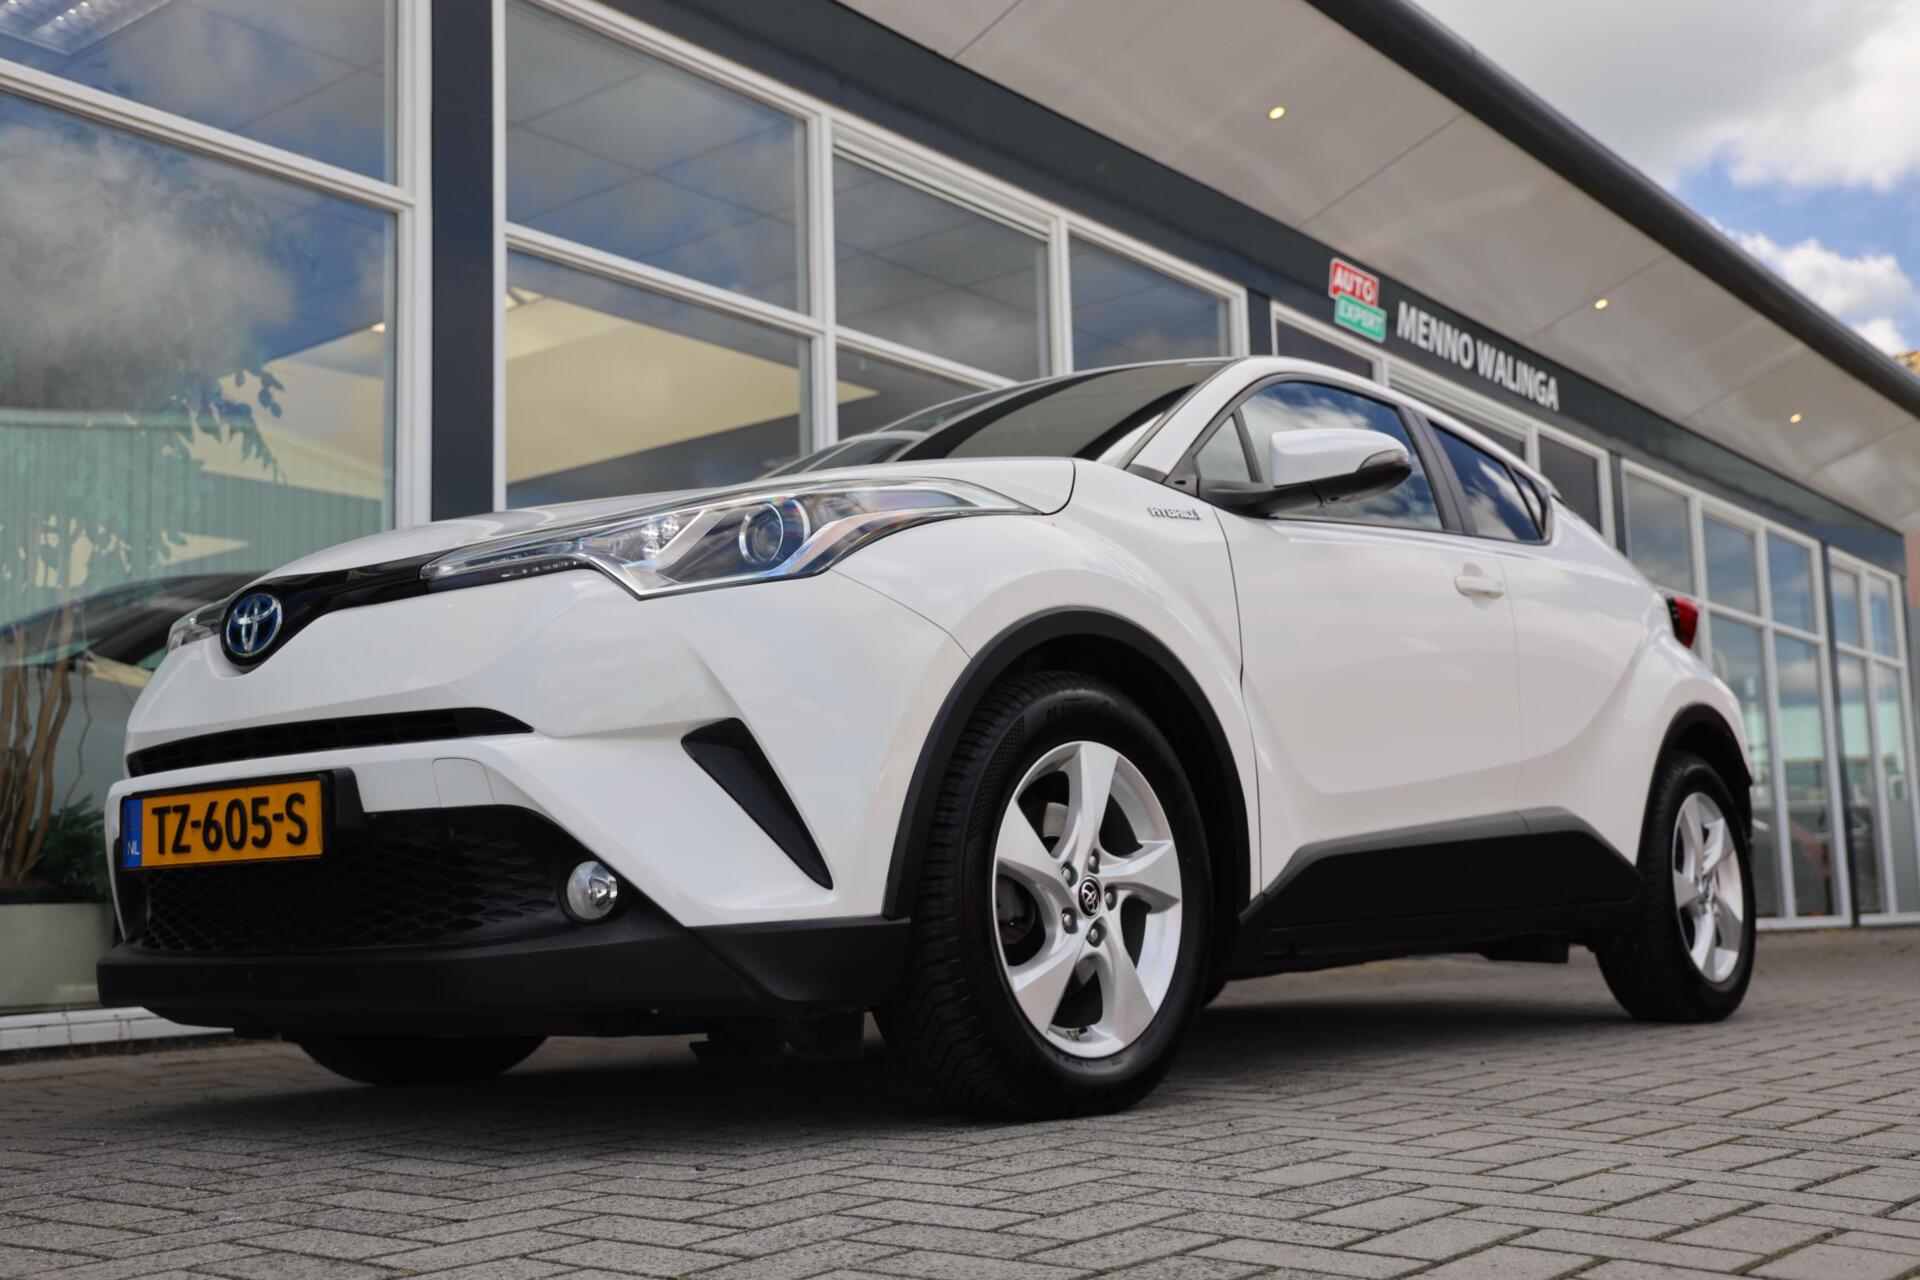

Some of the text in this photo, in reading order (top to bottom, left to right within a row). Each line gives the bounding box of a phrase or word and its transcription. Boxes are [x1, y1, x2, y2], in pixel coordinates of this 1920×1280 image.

[1334, 266, 1375, 302] AUTO
[1396, 301, 1560, 412] MENNO WALINGA
[152, 792, 309, 855] TZ-605-S
[127, 841, 141, 856] NL
